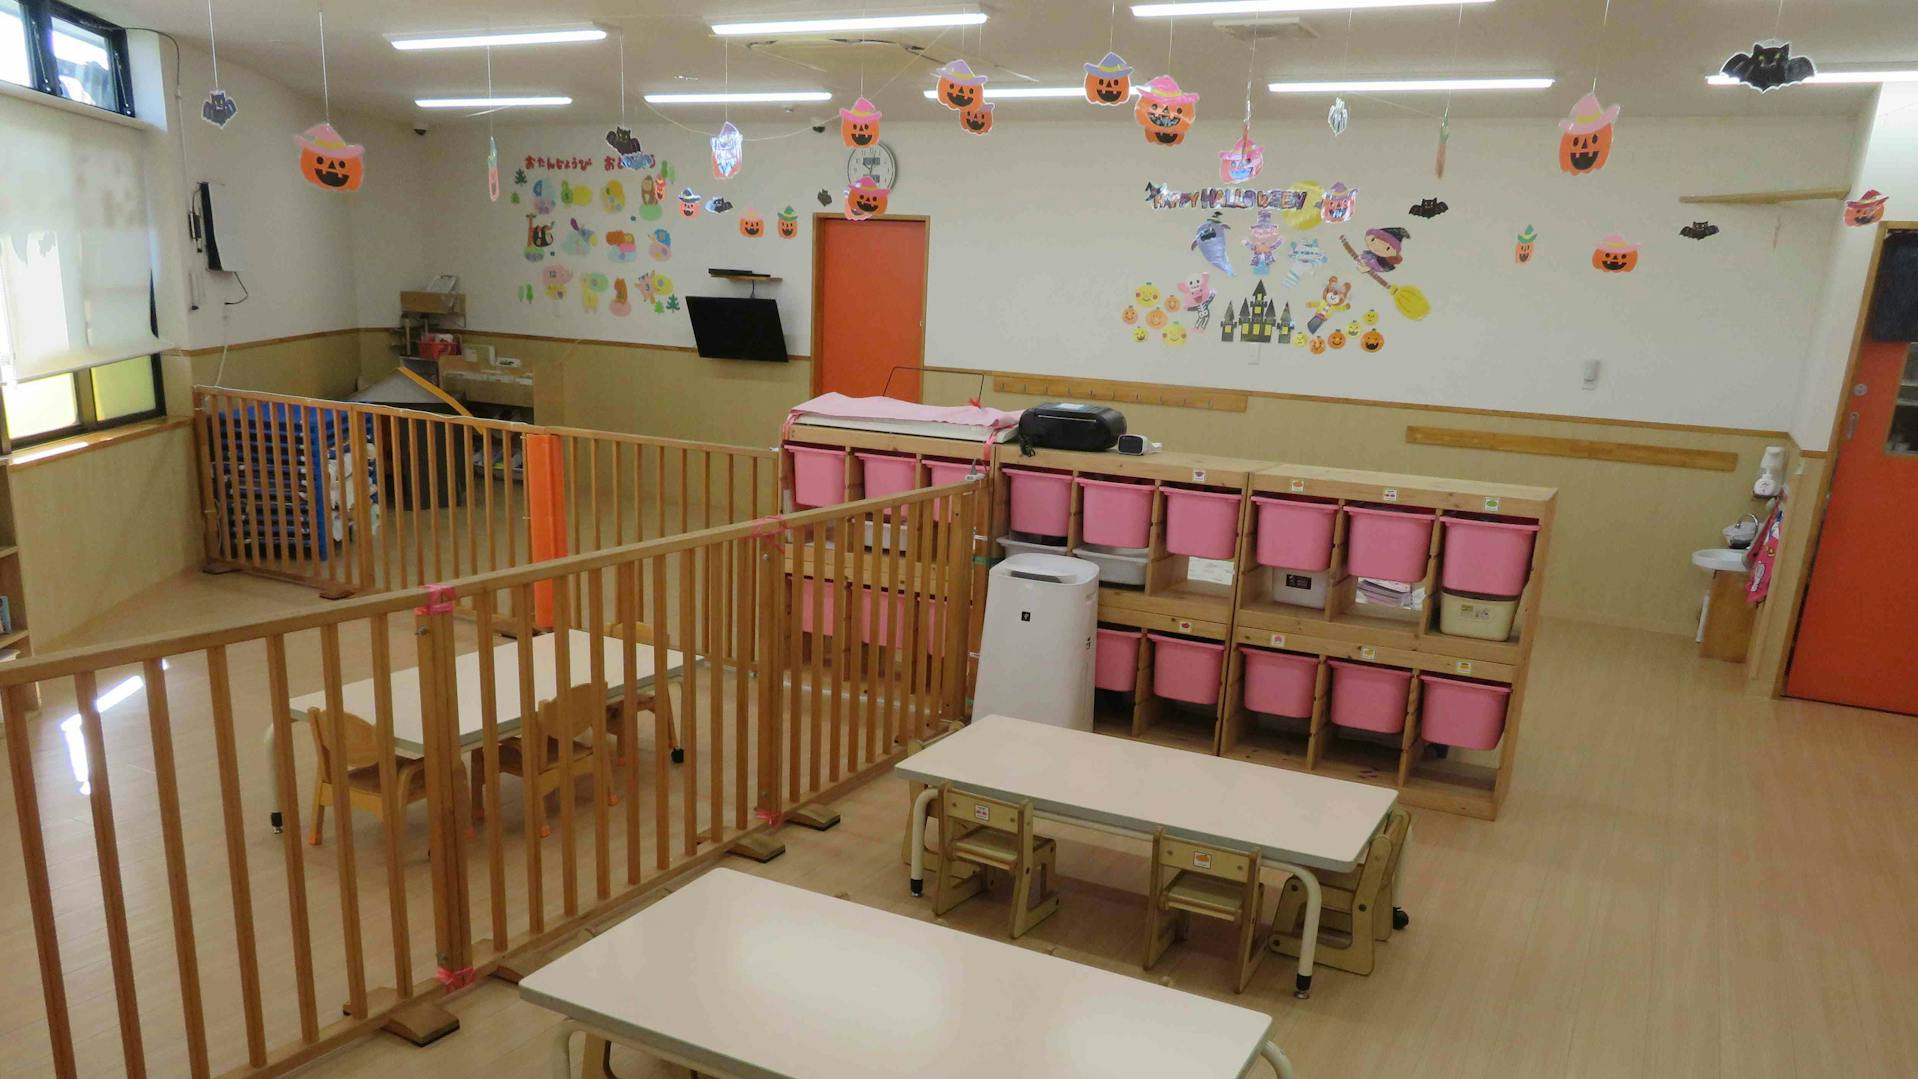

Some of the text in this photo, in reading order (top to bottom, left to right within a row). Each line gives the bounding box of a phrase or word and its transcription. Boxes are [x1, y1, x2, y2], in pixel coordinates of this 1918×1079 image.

[525, 155, 592, 171] おたんじょうび
[1153, 188, 1307, 209] HAPPY HALLOWEEN
